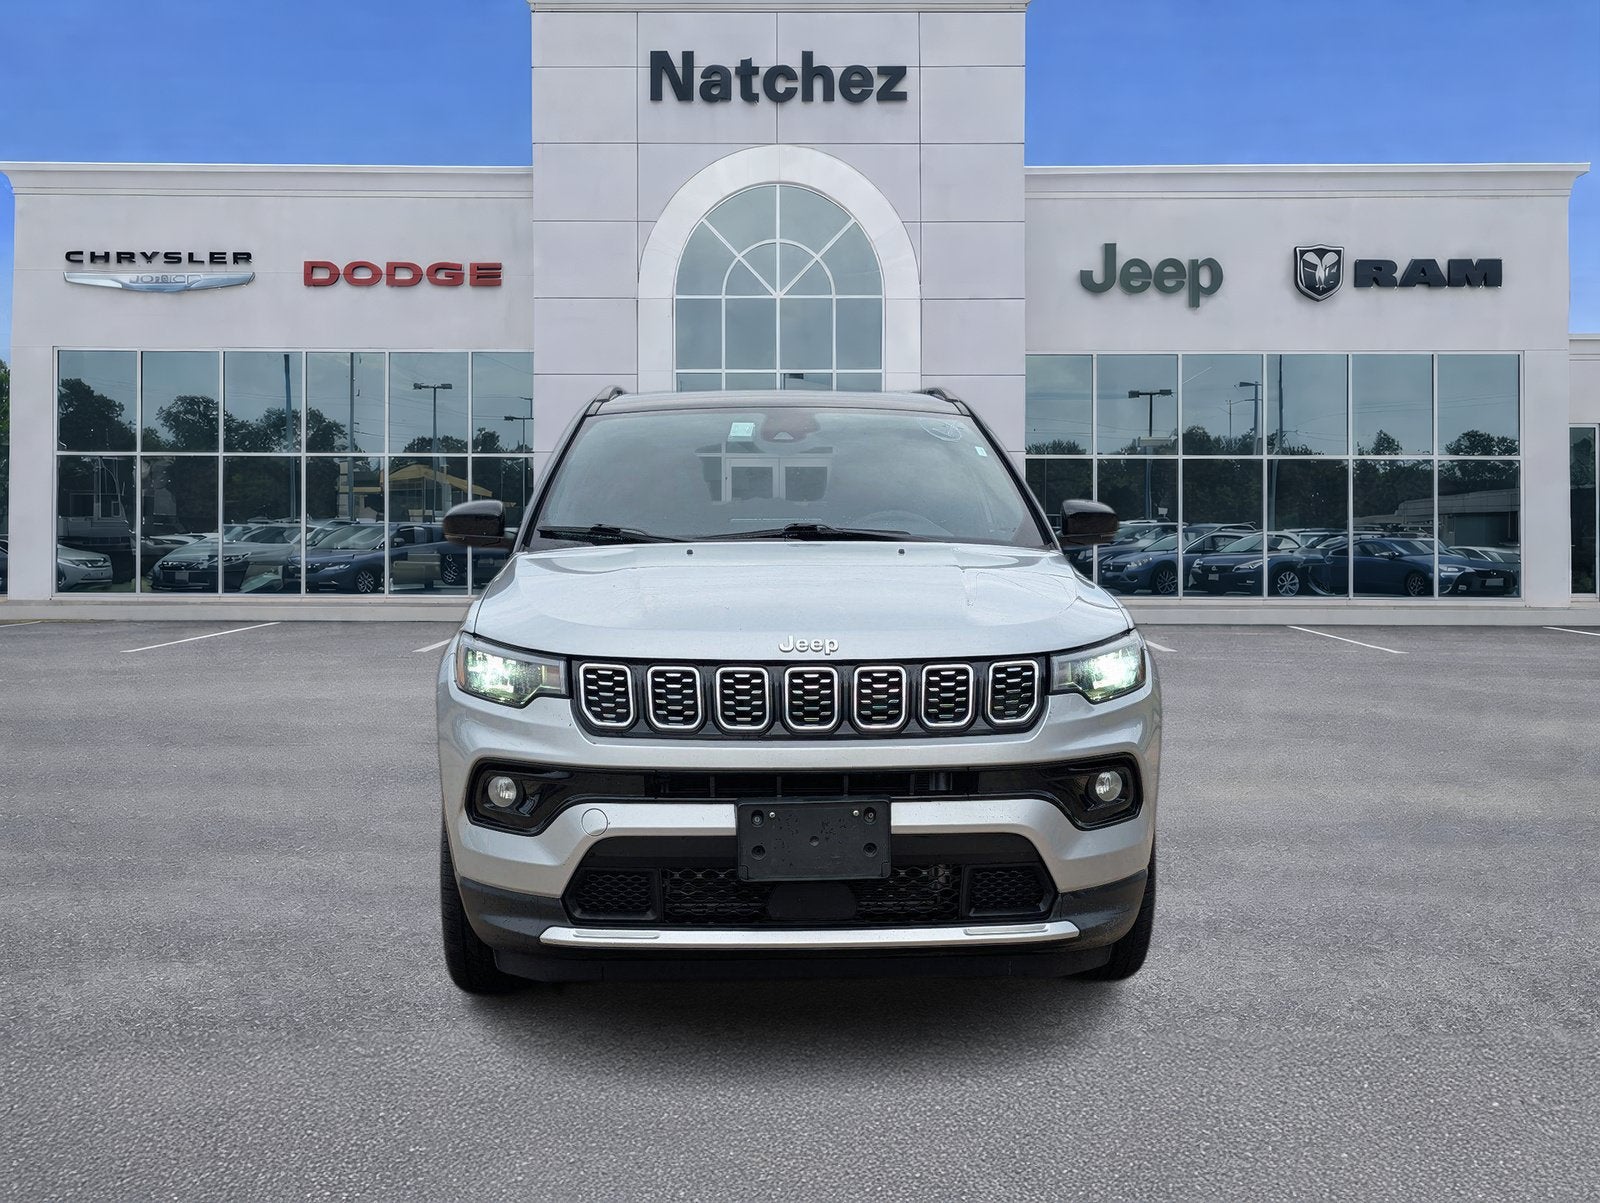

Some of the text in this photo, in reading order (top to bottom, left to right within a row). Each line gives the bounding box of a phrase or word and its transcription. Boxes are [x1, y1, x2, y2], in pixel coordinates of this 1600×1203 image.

[650, 50, 908, 103] Natchez
[65, 251, 252, 264] CHRYSLER
[303, 261, 503, 287] DODGE
[1079, 242, 1224, 309] Jeep
[1354, 258, 1503, 288] RAM
[779, 634, 839, 656] Jeep
